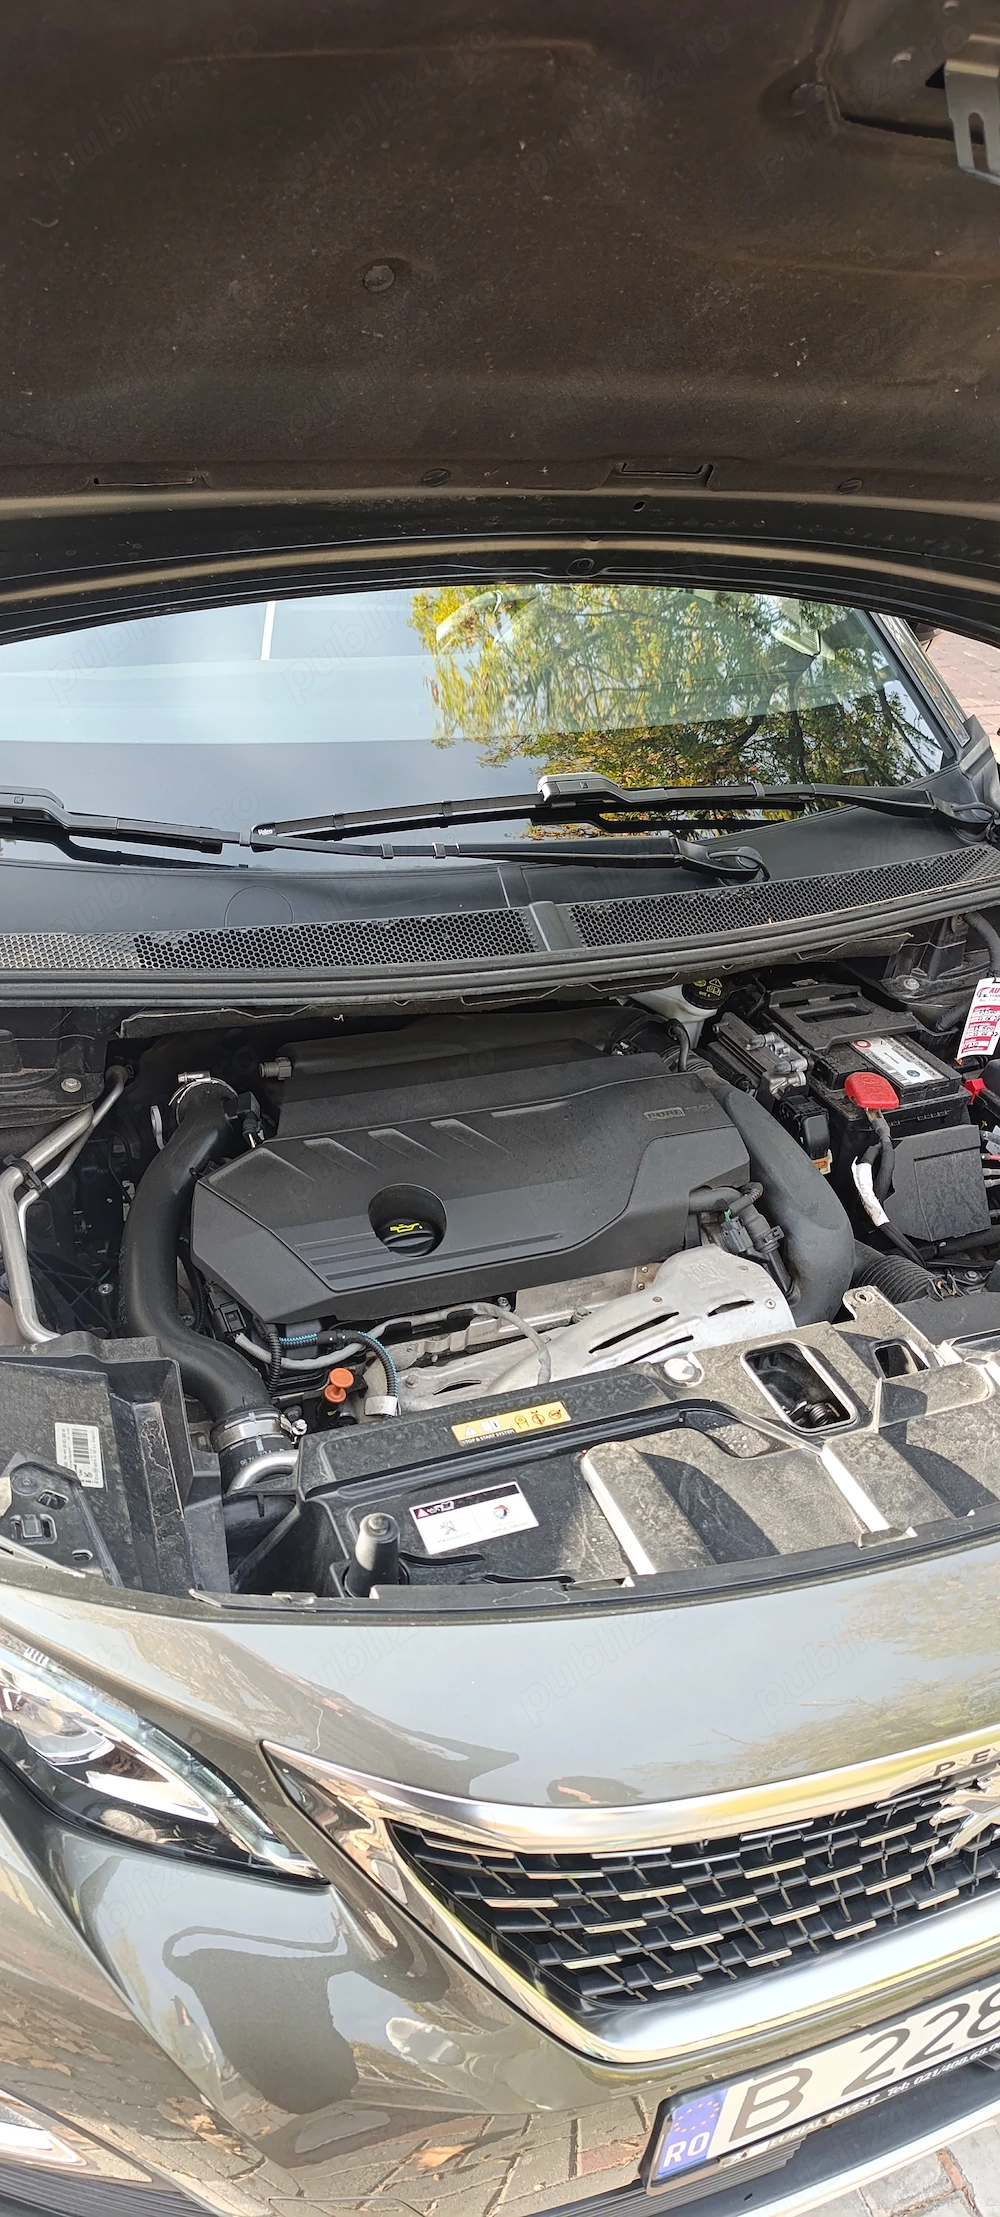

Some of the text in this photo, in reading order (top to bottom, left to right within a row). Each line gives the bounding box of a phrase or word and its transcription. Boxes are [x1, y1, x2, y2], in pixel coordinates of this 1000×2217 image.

[728, 2067, 813, 2143] B
[825, 2094, 880, 2123] INVEST
[887, 2081, 911, 2096] Tel:
[663, 2131, 711, 2168] RO
